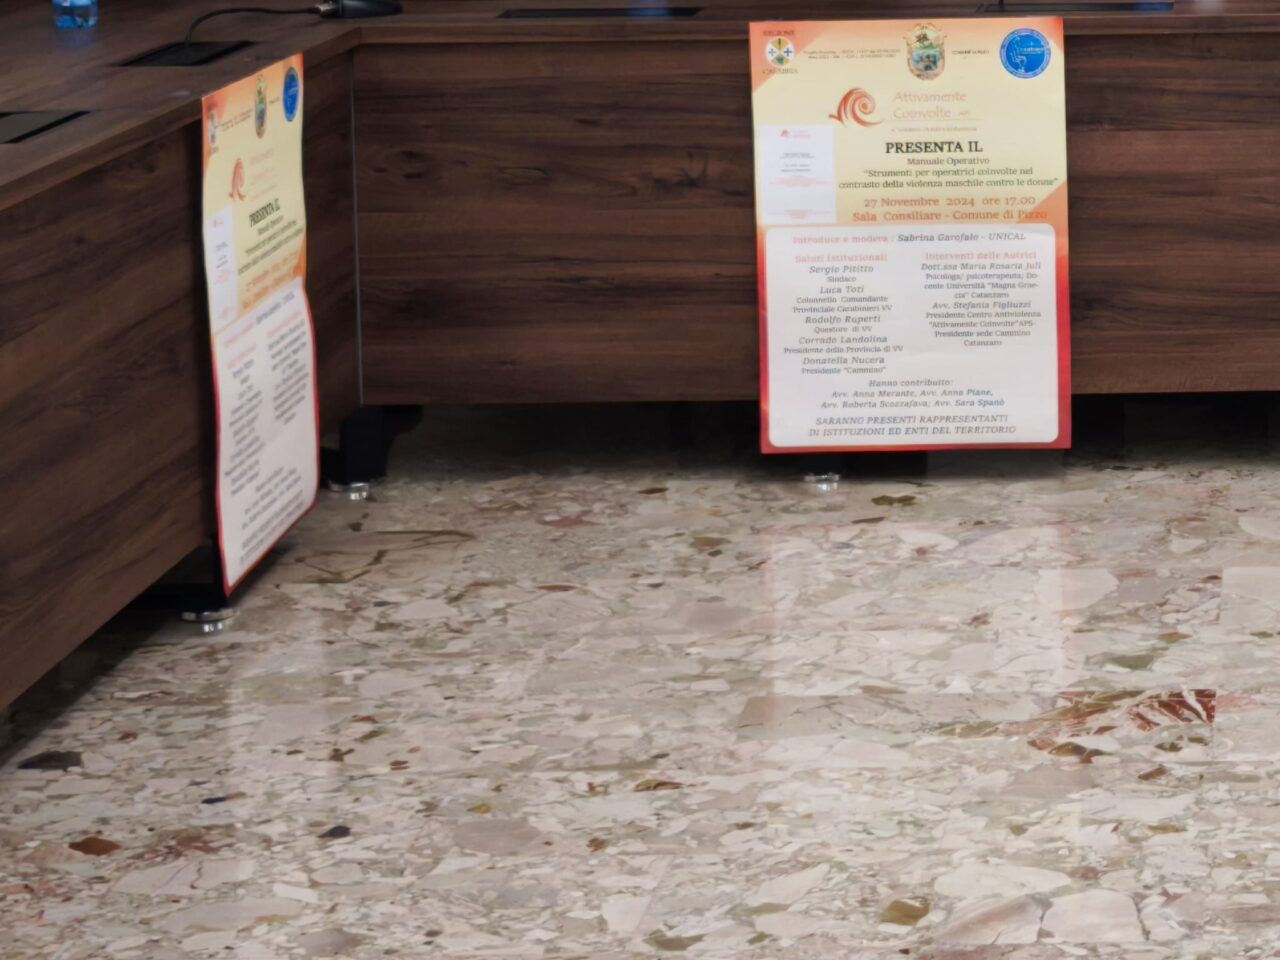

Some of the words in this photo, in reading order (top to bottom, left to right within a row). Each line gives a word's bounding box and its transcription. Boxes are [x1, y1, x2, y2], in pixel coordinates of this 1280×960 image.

[885, 141, 964, 154] PRESENTA
[968, 141, 983, 153] IL
[881, 196, 939, 206] Novembre
[946, 198, 975, 208] 2024
[952, 210, 999, 220] Comune
